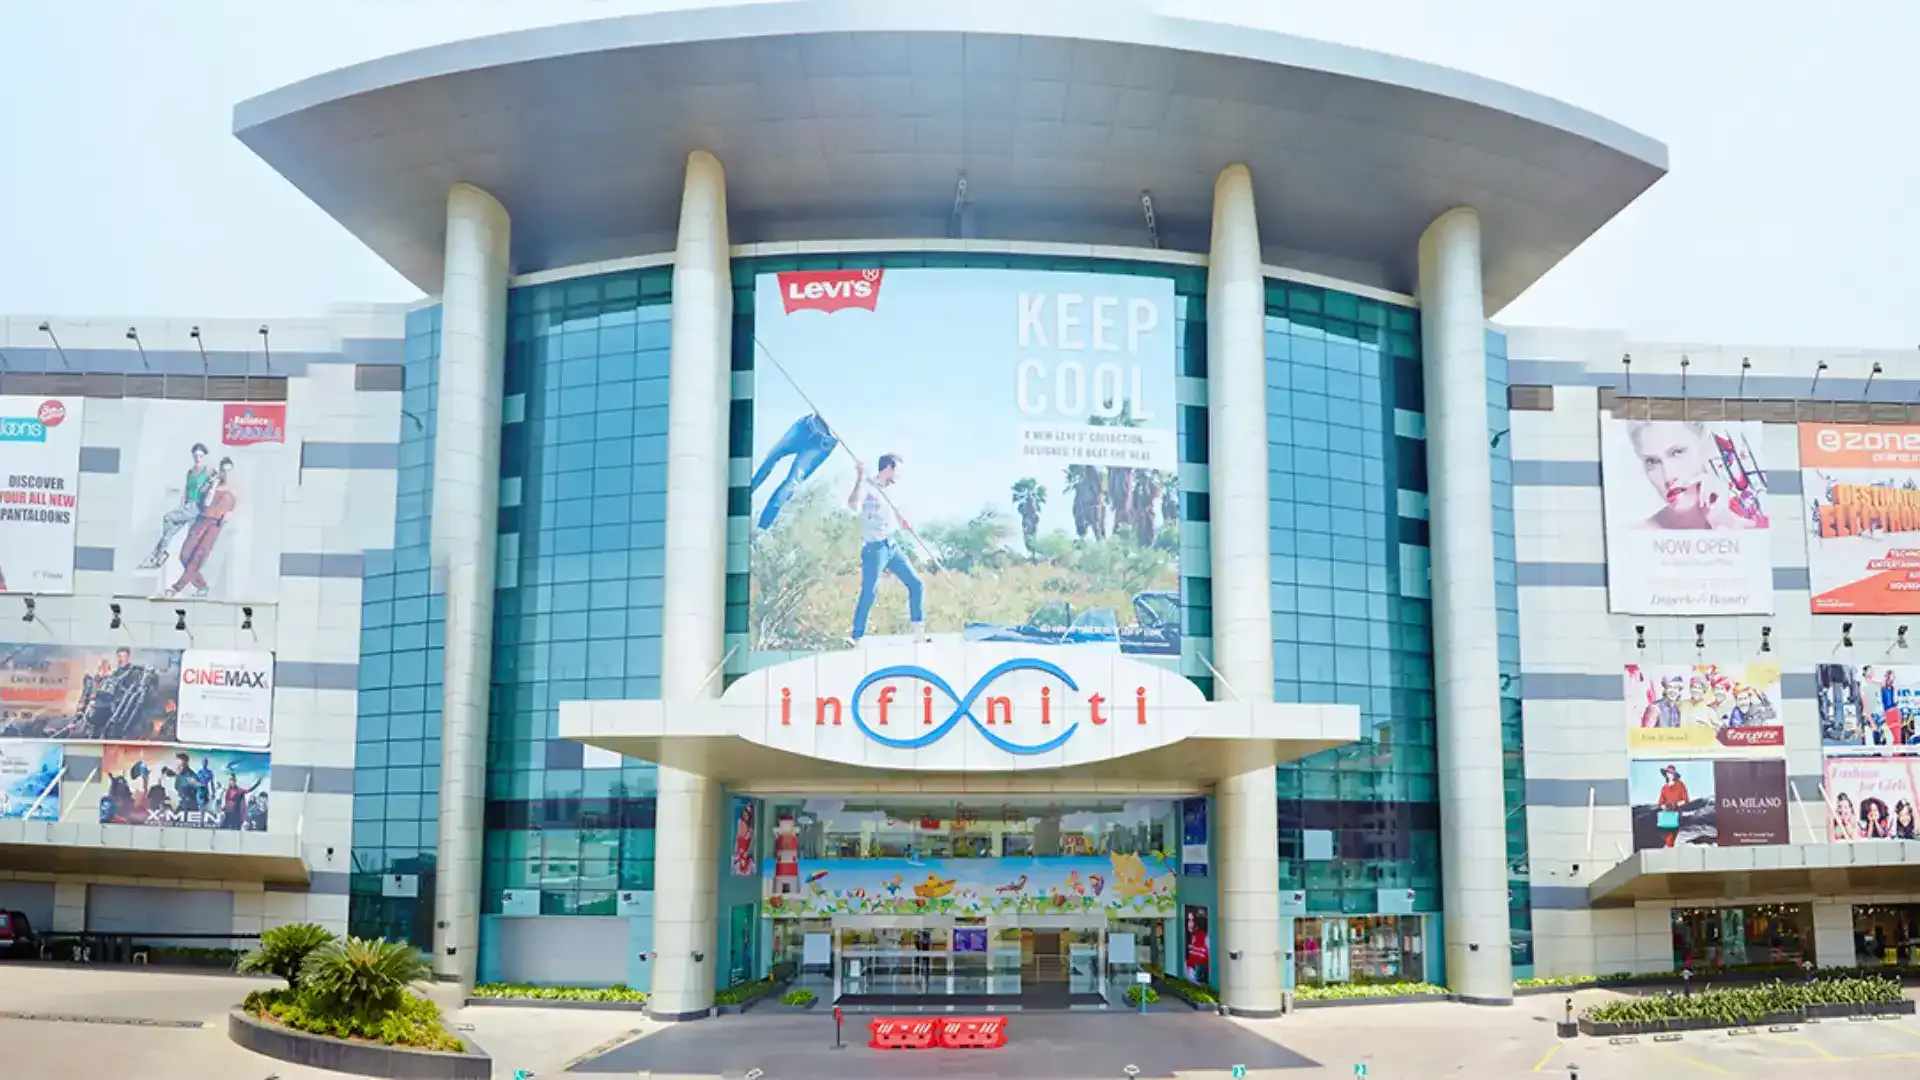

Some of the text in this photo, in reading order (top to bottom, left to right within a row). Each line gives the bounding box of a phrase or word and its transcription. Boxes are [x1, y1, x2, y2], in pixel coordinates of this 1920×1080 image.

[1017, 292, 1158, 354] KEEP
[1017, 357, 1156, 420] COOL
[9, 475, 64, 490] DISCOVER
[29, 491, 46, 505] ALL
[49, 493, 76, 508] NEW
[0, 508, 70, 524] PANTALOONS
[1653, 539, 1740, 555] NOW OPEN
[183, 668, 265, 688] CINEMAX
[781, 685, 1148, 726] infiniti
[1722, 796, 1782, 809] DA MILANO
[147, 808, 223, 824] X-MEN
